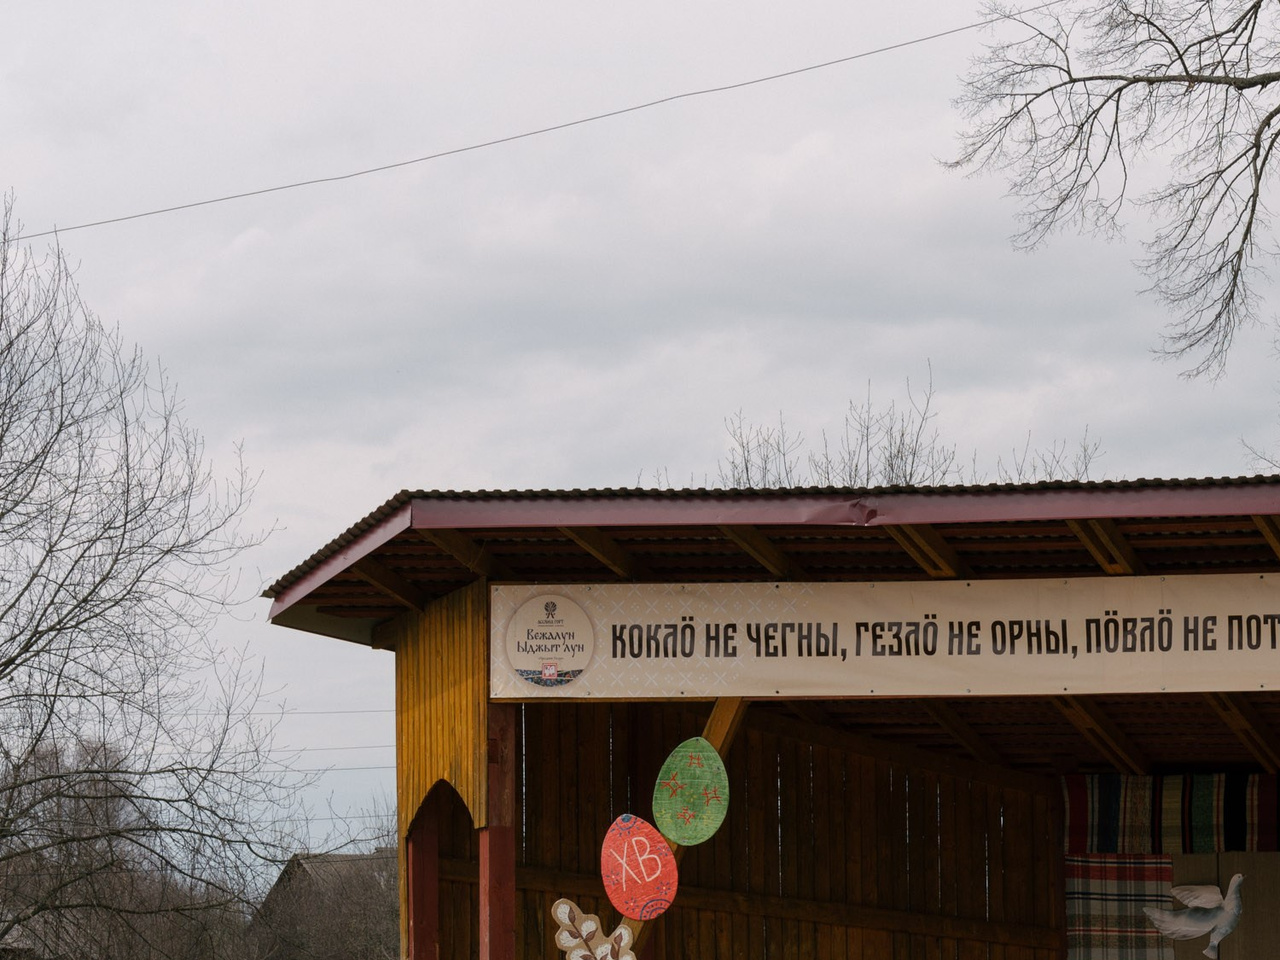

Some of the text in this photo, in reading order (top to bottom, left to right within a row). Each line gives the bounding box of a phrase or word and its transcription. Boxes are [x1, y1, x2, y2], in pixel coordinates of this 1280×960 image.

[526, 628, 575, 646] Вежалун
[611, 615, 696, 659] КОКЛӦ
[705, 622, 738, 658] НЕ
[746, 622, 847, 662] ЧЕГНЫ,
[855, 613, 939, 657] ГЕЗЛӦ
[947, 620, 982, 656] НЕ
[990, 618, 1078, 659] ОРНЫ,
[1085, 608, 1173, 654] ПӦВЛӦ
[1183, 615, 1218, 652] НЕ
[516, 640, 585, 658] Ыджыт лун
